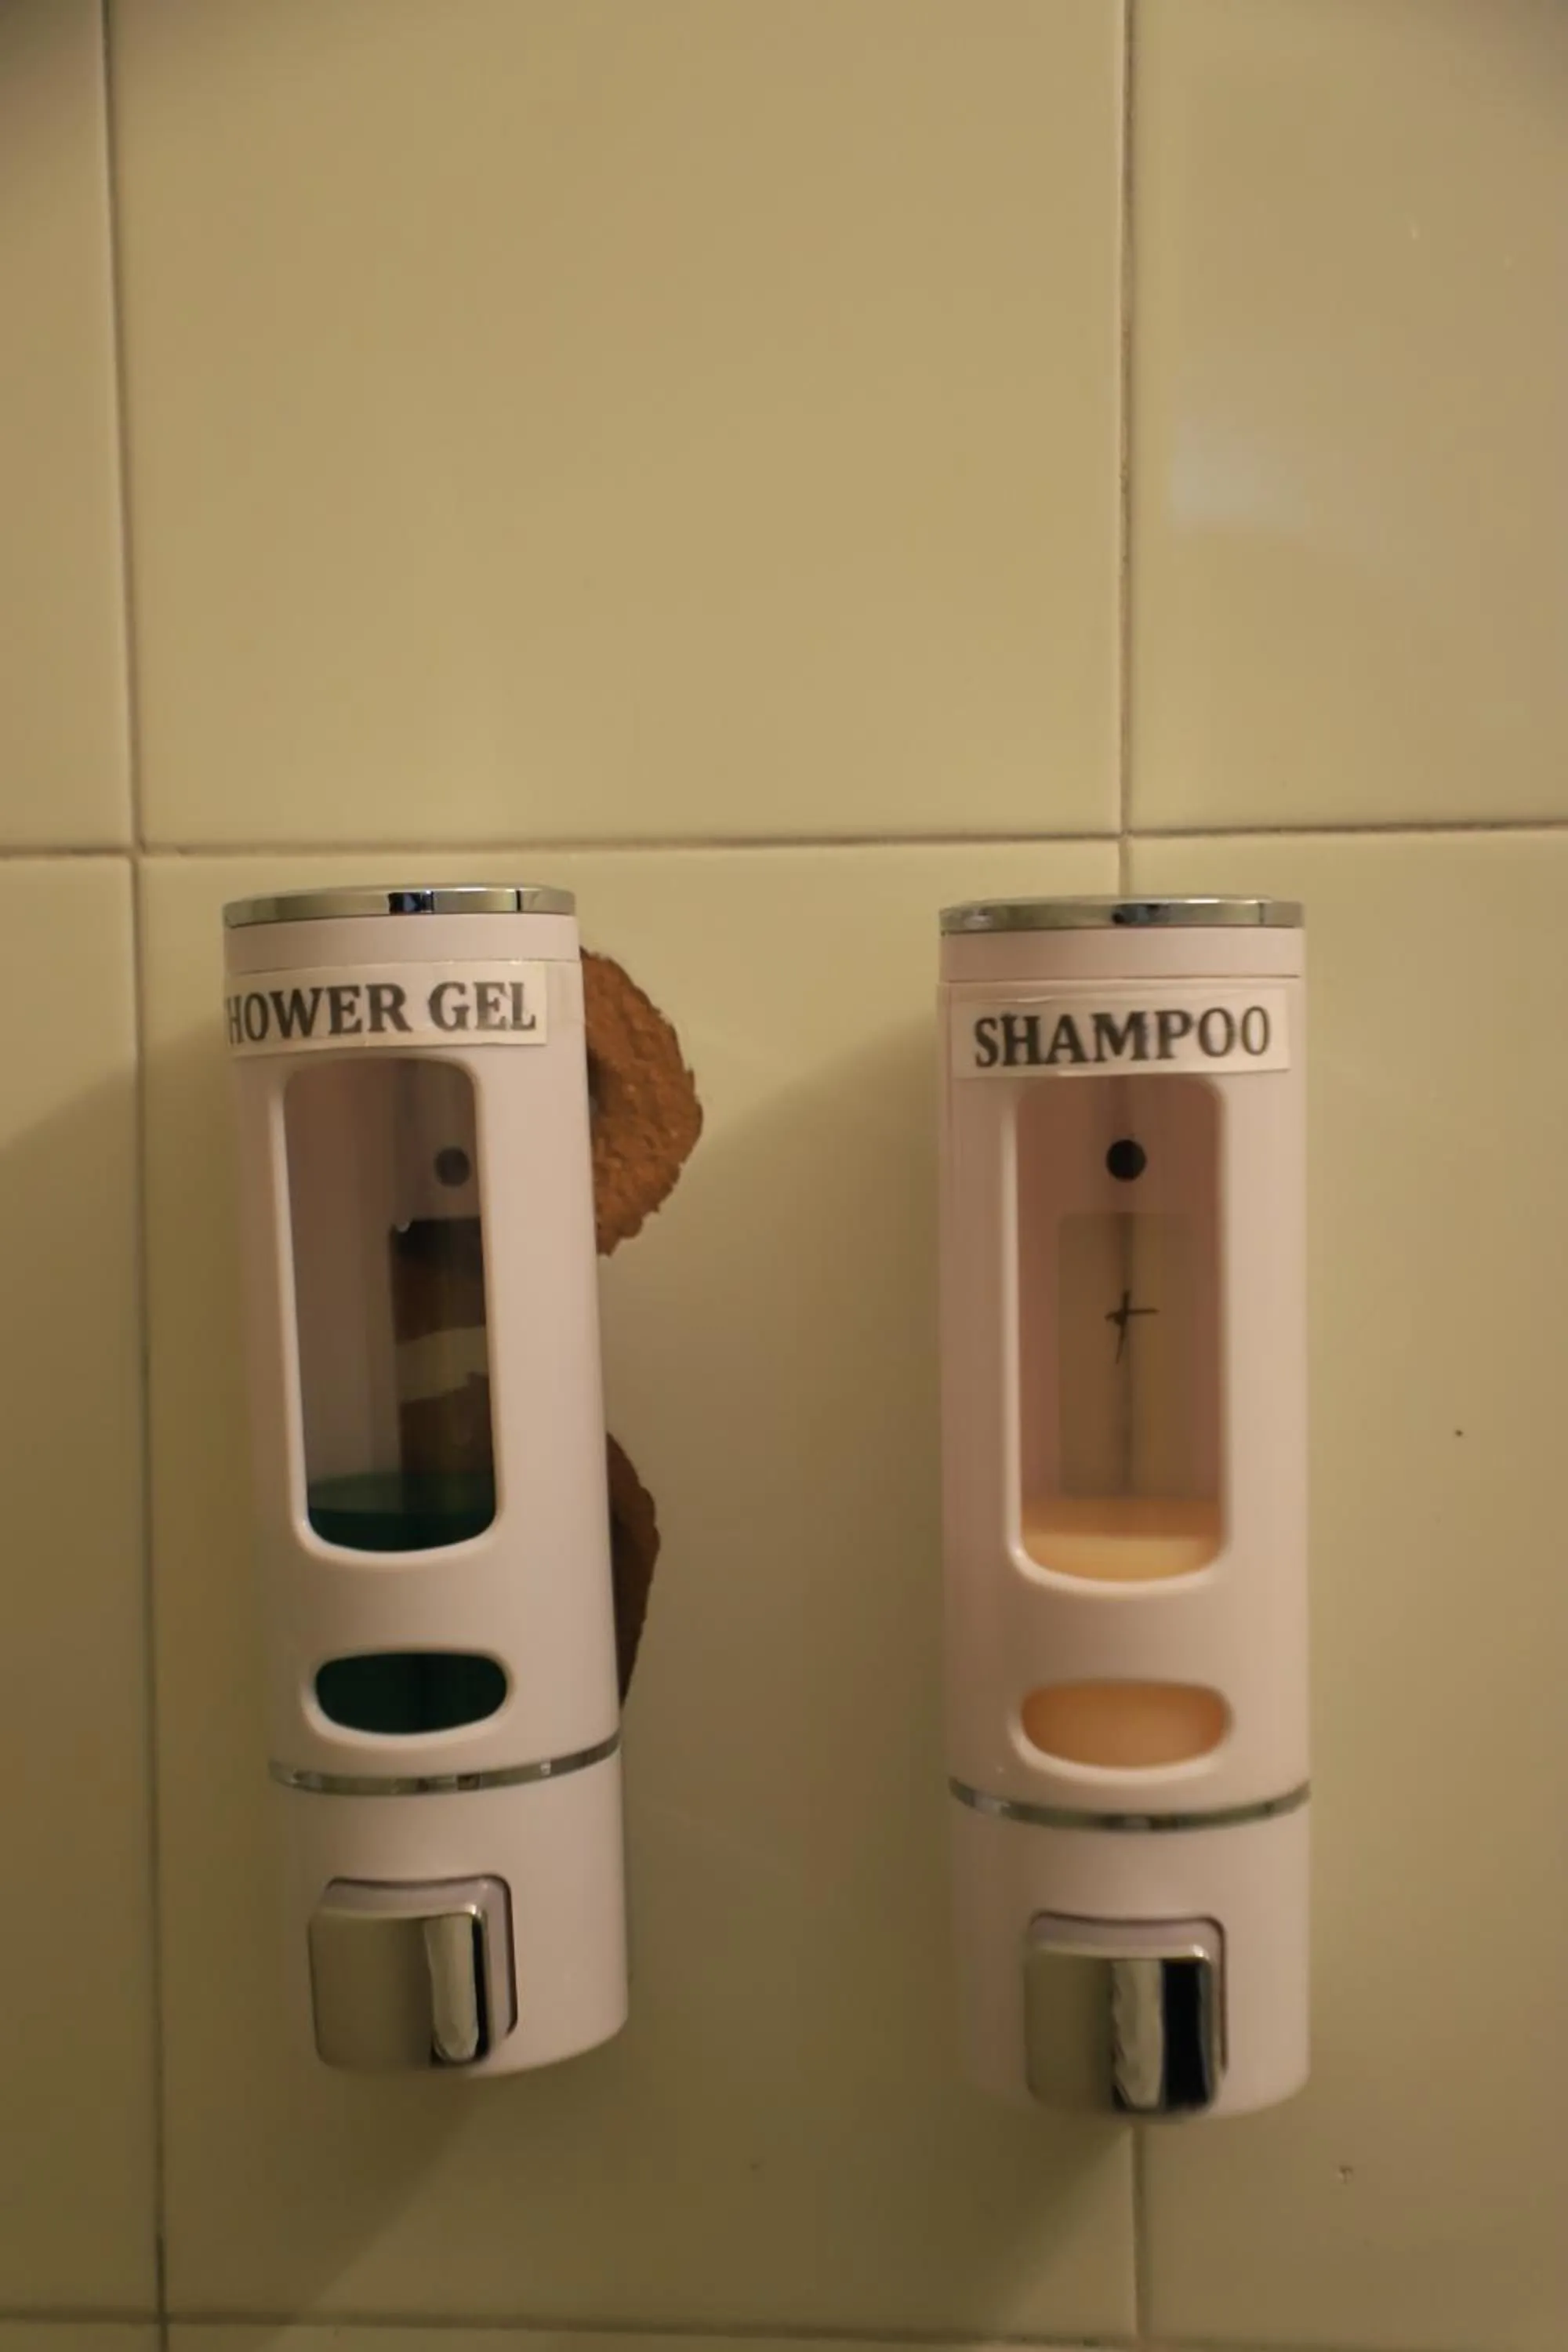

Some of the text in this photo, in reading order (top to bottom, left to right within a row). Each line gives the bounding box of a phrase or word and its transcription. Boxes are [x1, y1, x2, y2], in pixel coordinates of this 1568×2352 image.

[226, 981, 536, 1045] HOWER GEL
[974, 1006, 1271, 1068] SHAMPOO
